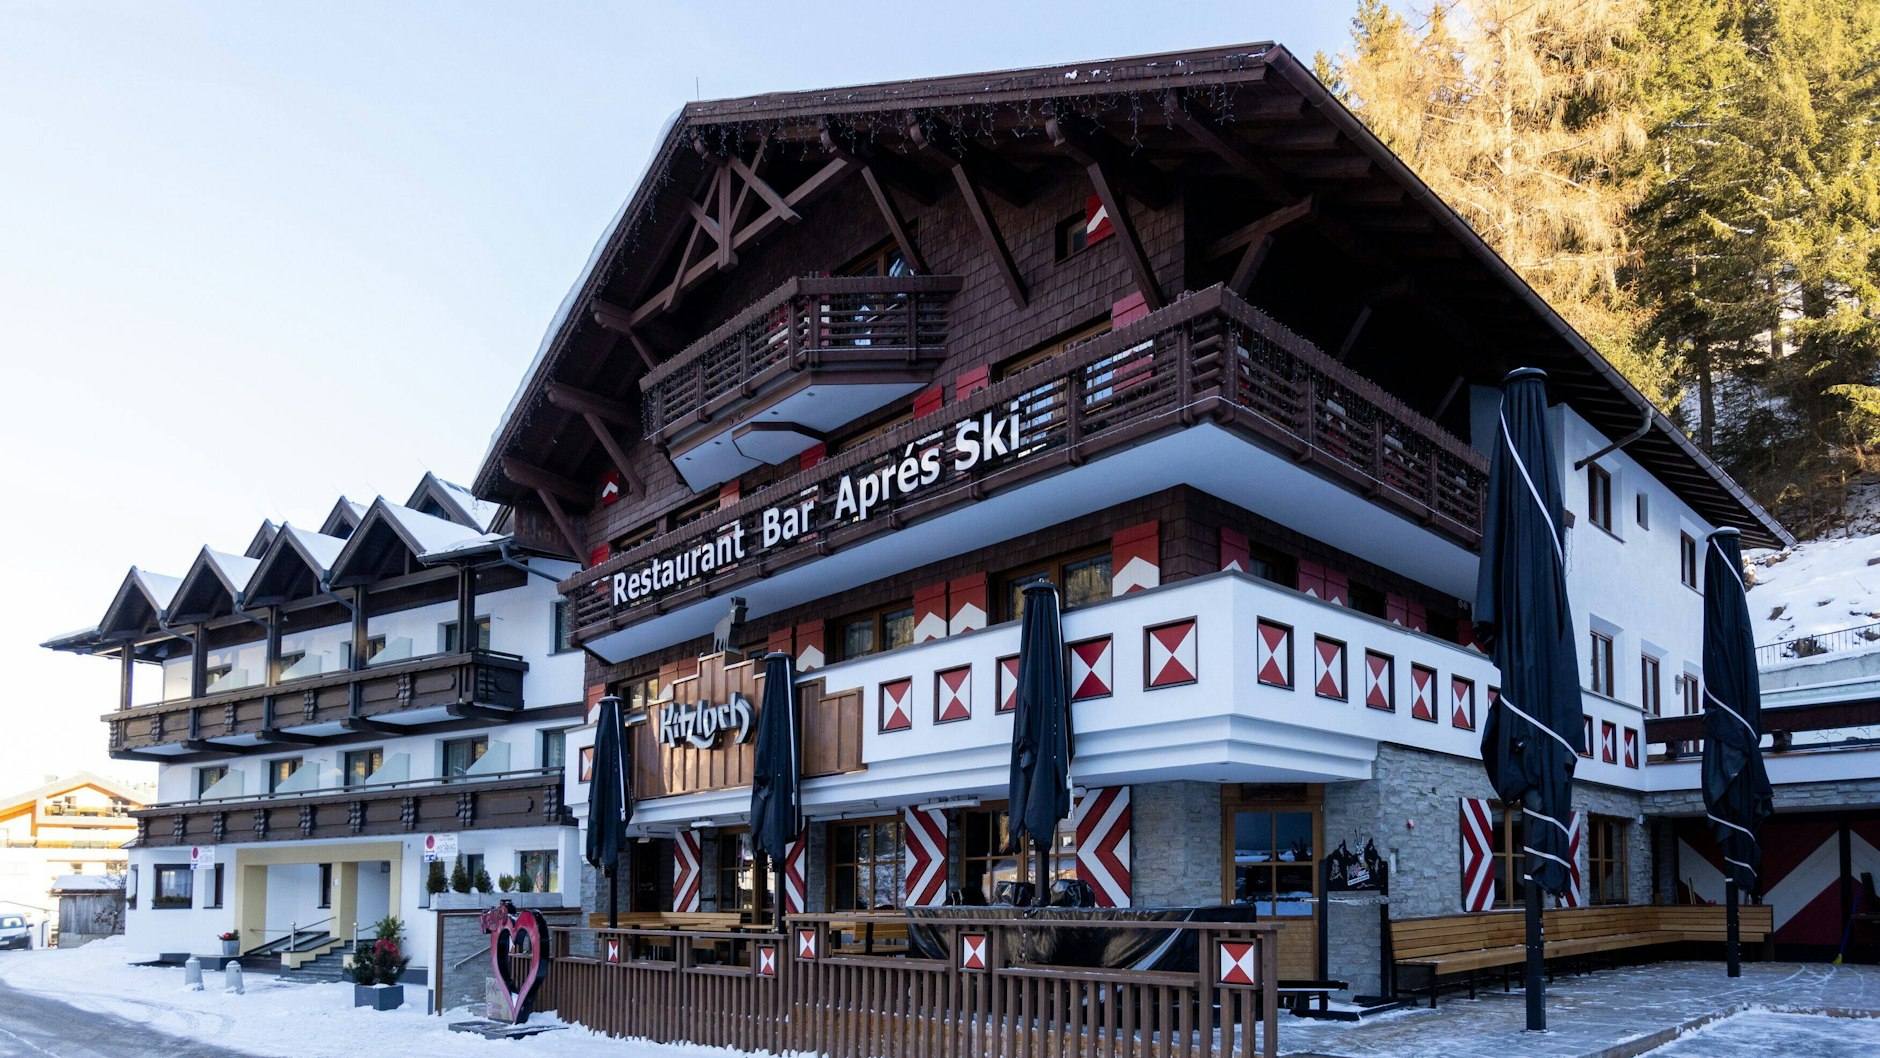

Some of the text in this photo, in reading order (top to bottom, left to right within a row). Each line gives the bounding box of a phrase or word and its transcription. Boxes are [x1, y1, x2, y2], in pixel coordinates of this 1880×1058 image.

[613, 400, 1020, 606] Restaurant Bar Aprés Ski
[660, 692, 751, 749] Kitzloch
